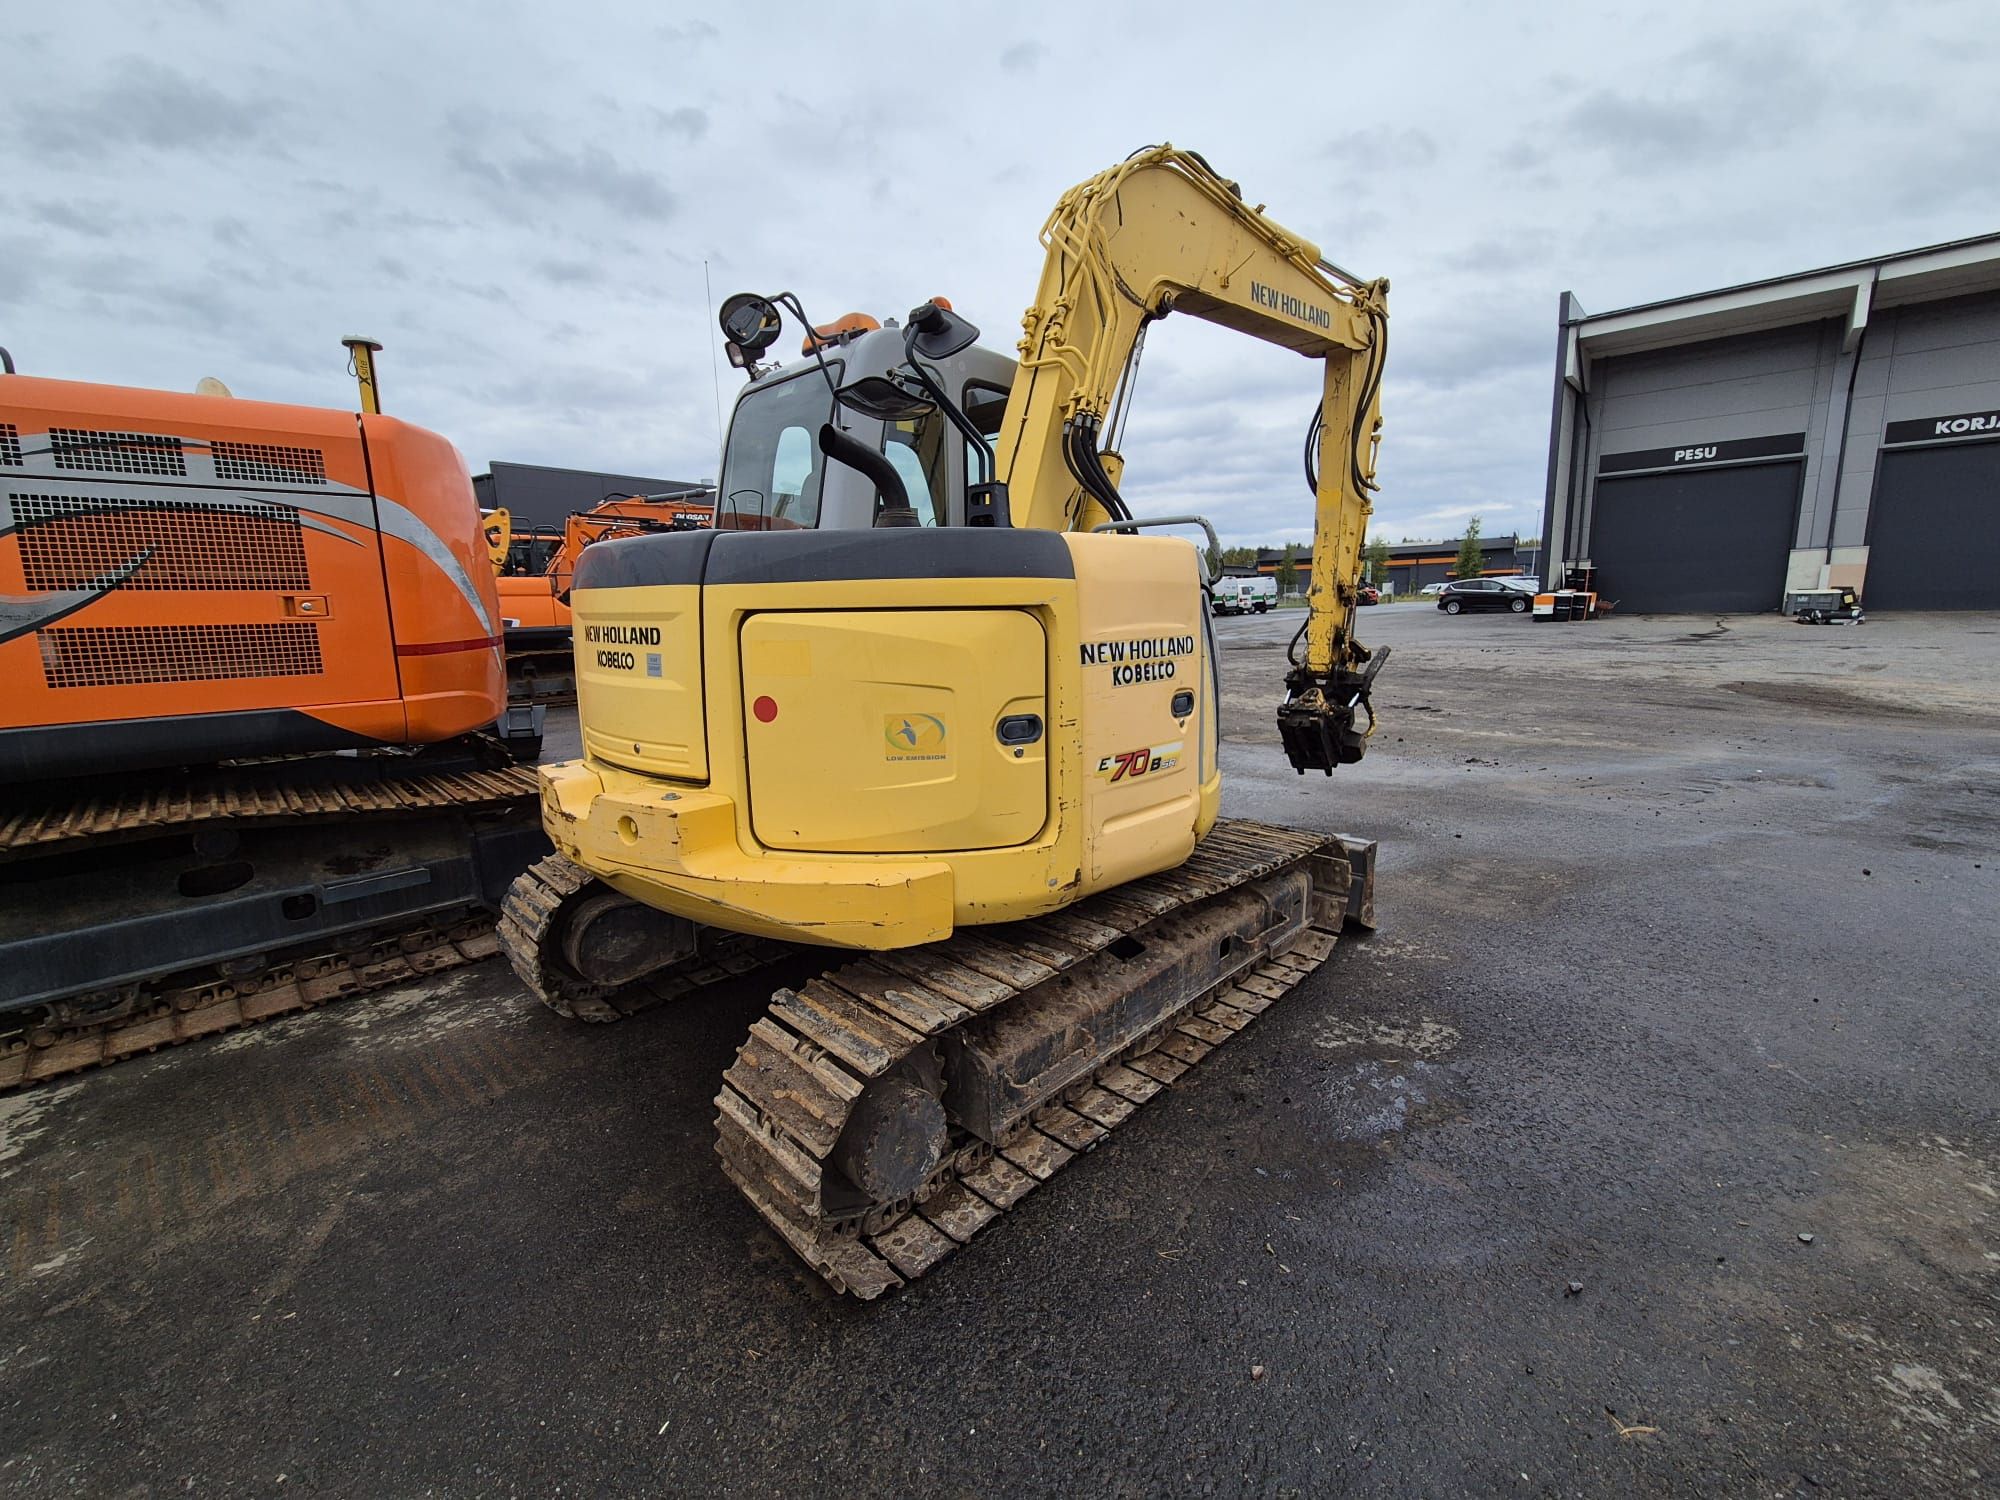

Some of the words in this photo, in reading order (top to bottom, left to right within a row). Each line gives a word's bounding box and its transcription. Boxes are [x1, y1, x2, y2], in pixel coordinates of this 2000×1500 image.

[1251, 281, 1279, 309] NEW
[1282, 293, 1330, 329] HOLLAND
[1935, 416, 2000, 434] KORJ
[1674, 446, 1717, 462] PESU
[585, 625, 601, 642] NEW
[602, 626, 661, 645] HOLLAND
[597, 650, 635, 670] KOBELCO
[1080, 642, 1125, 664] NEW
[1129, 636, 1194, 660] HOLLAND
[1112, 660, 1175, 686] KOBELCO
